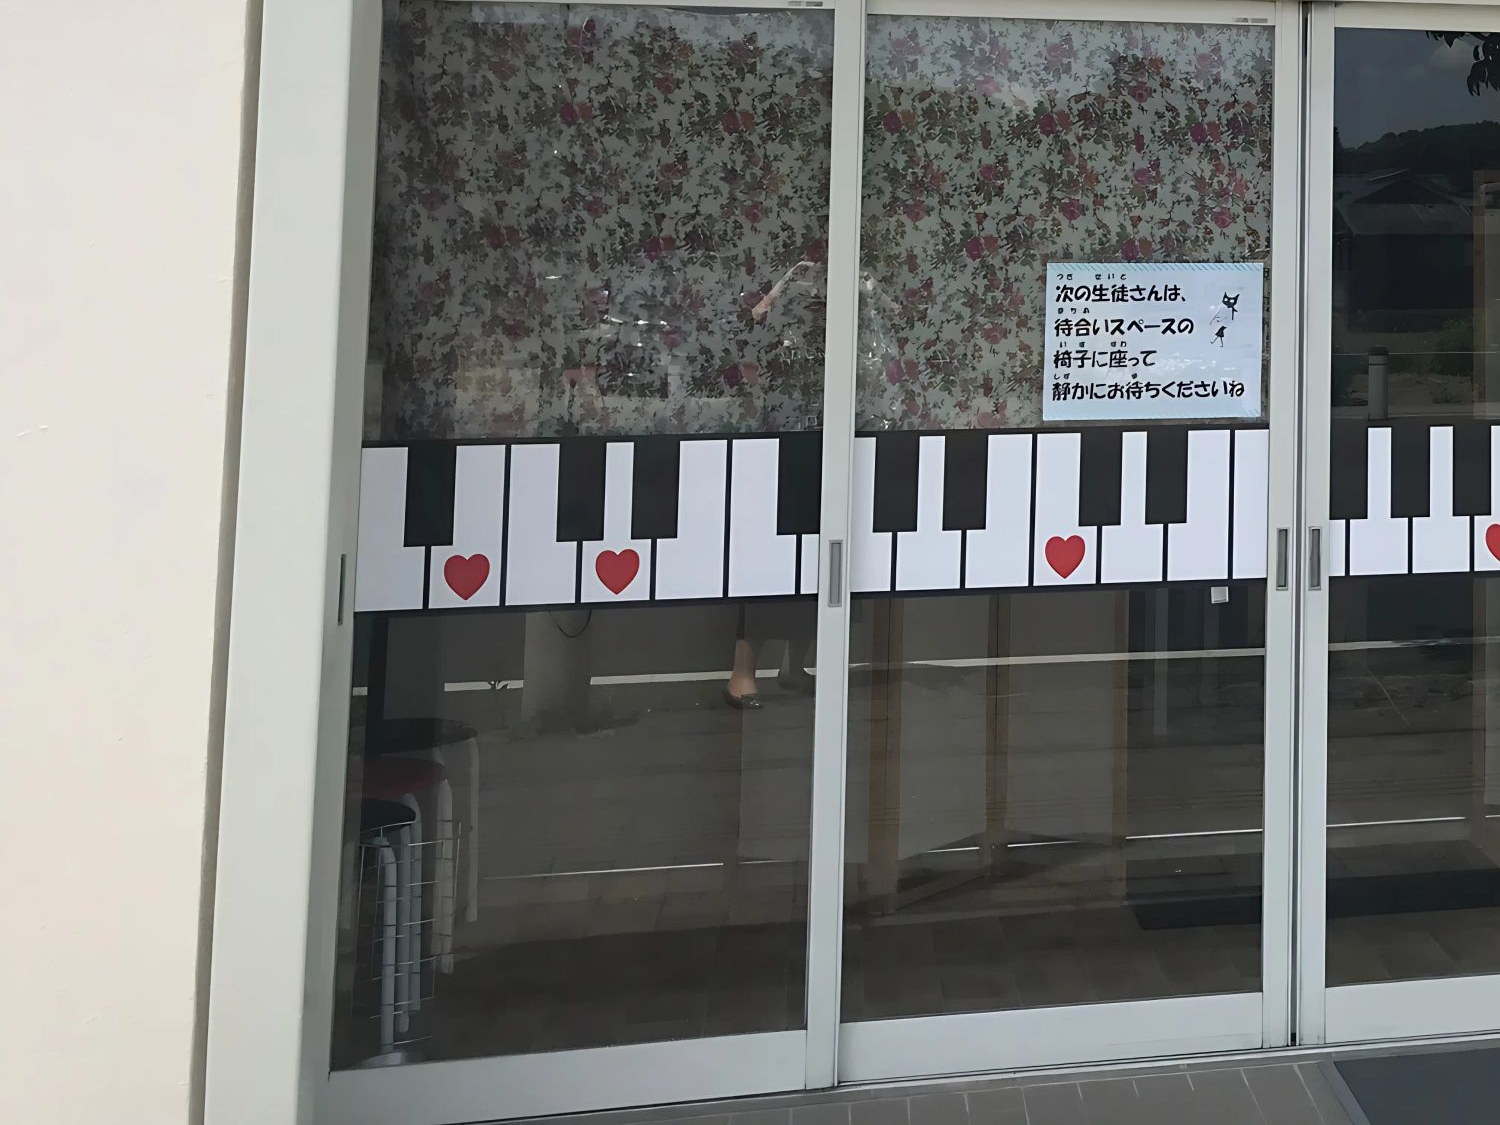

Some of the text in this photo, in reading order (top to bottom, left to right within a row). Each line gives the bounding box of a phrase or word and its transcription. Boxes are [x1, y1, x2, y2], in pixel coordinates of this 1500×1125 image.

[1055, 284, 1187, 303] 次の生徒さんは、
[1054, 318, 1195, 337] 待合いスペースの
[1053, 349, 1157, 368] 椅子に座って
[1052, 380, 1245, 401] 静かにお待ちくださいね
